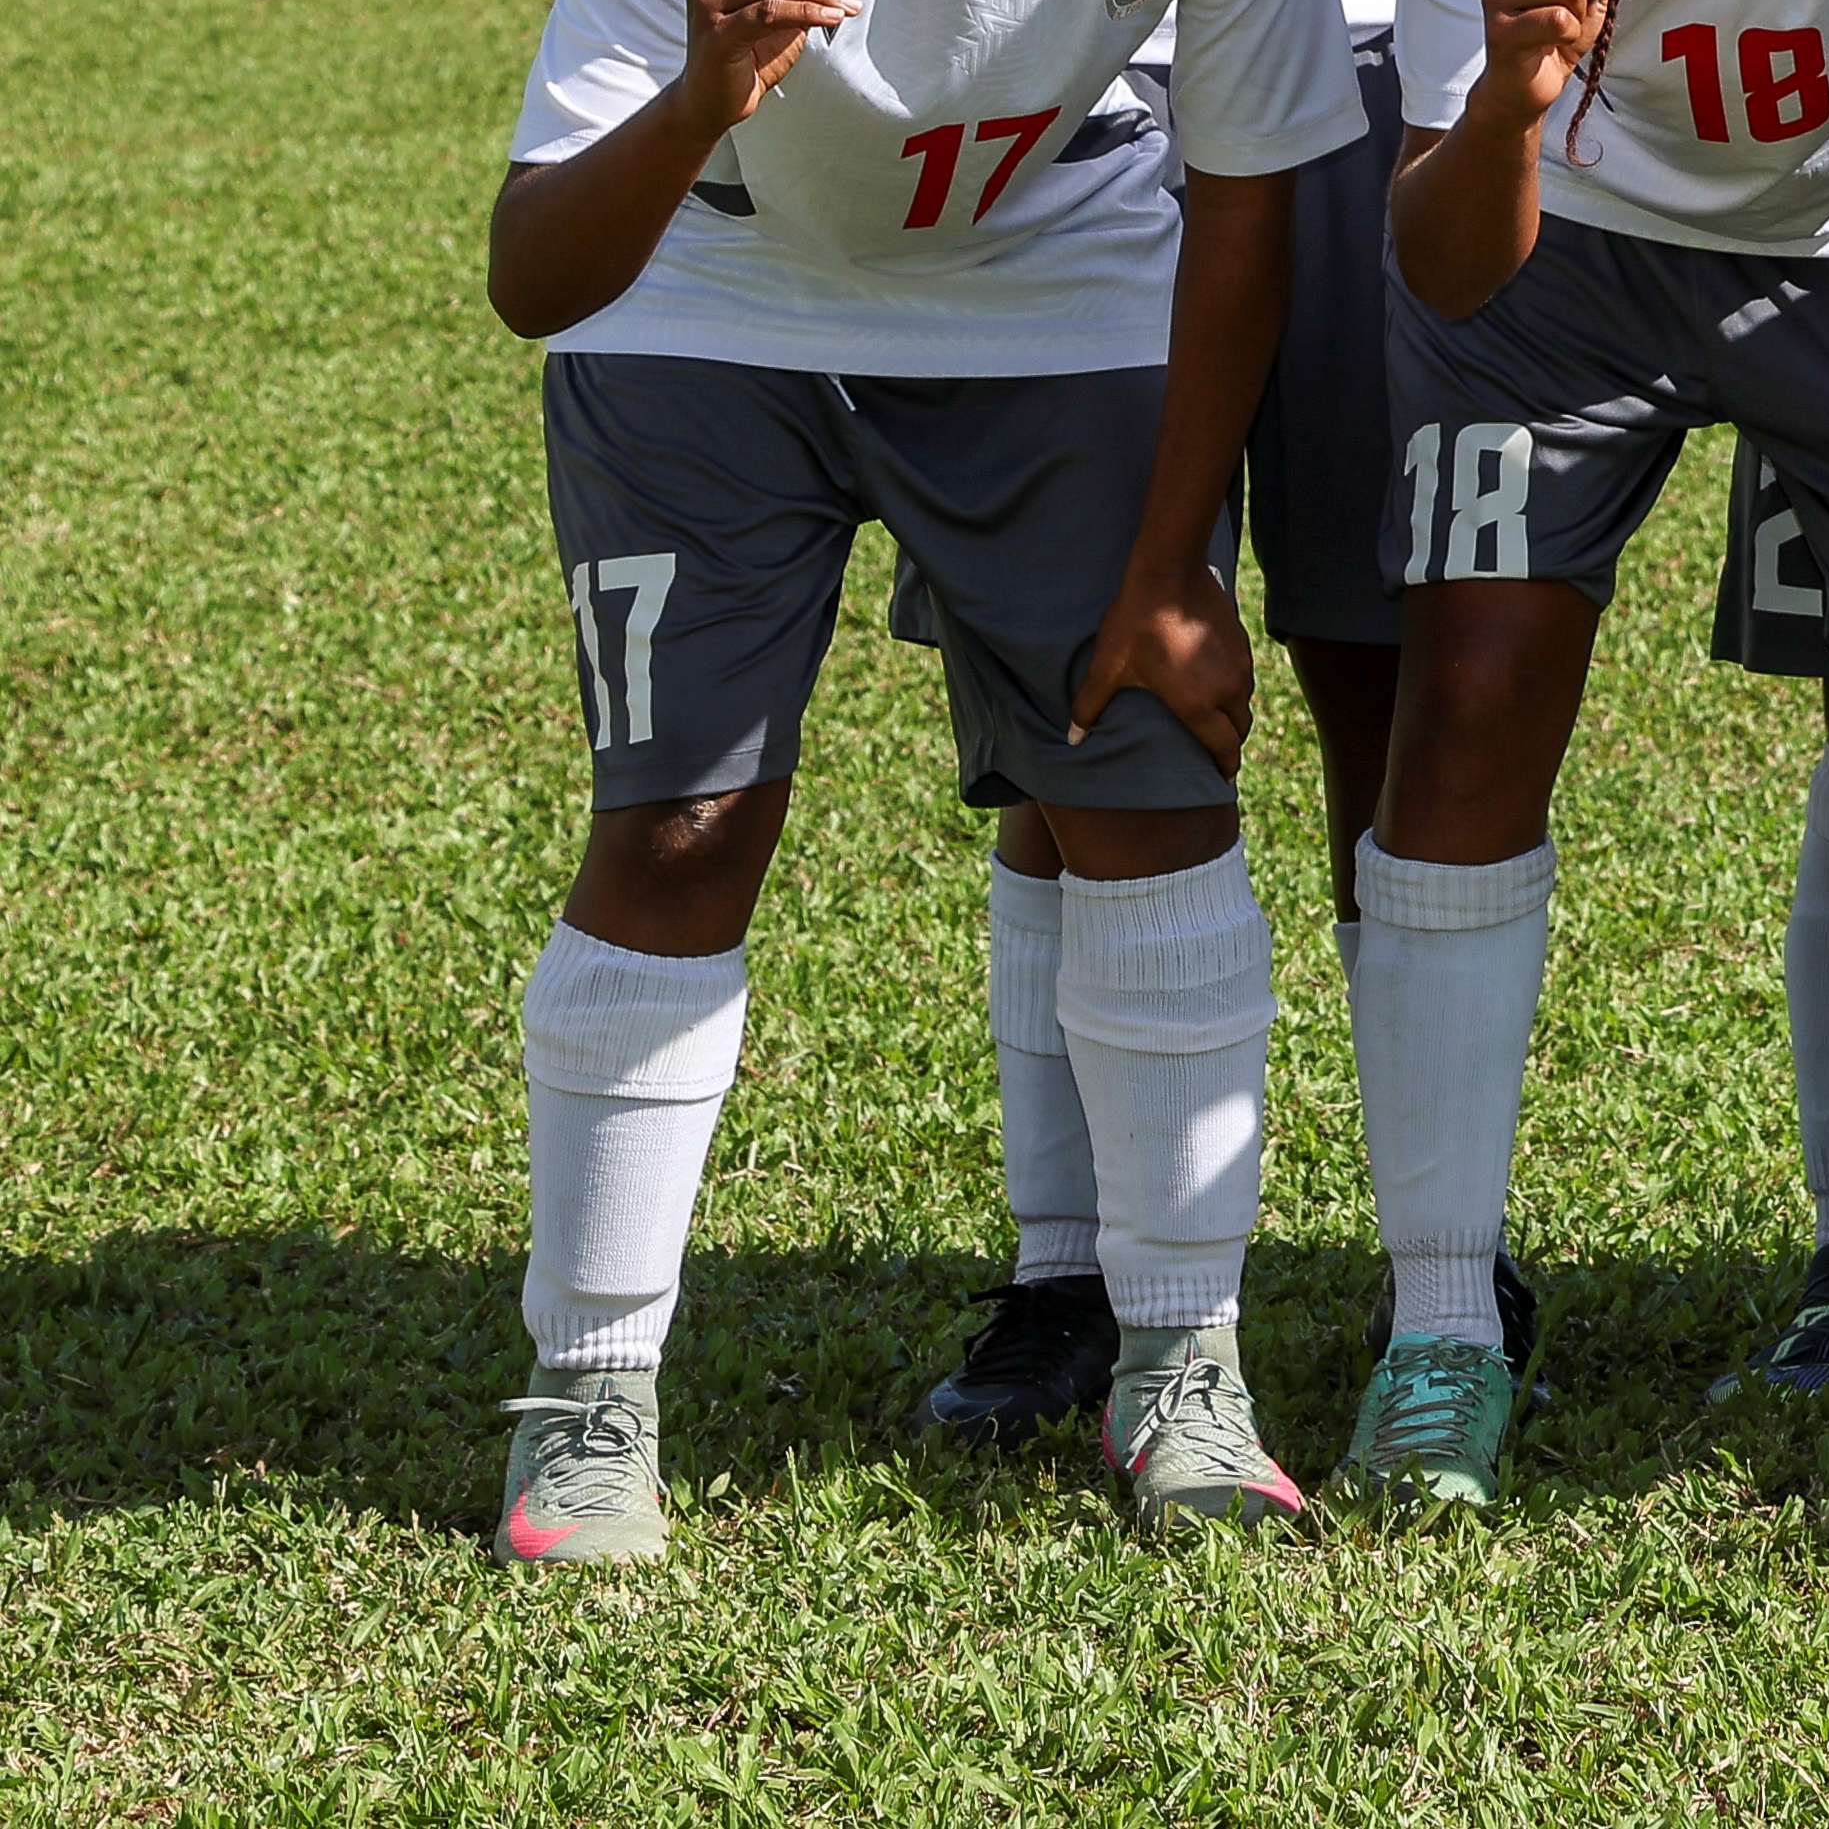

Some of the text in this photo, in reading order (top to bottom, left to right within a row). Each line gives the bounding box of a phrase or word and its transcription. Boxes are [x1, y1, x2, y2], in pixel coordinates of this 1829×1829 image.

[901, 106, 1062, 230] 17
[1403, 422, 1534, 585] 18
[571, 551, 677, 751] 17
